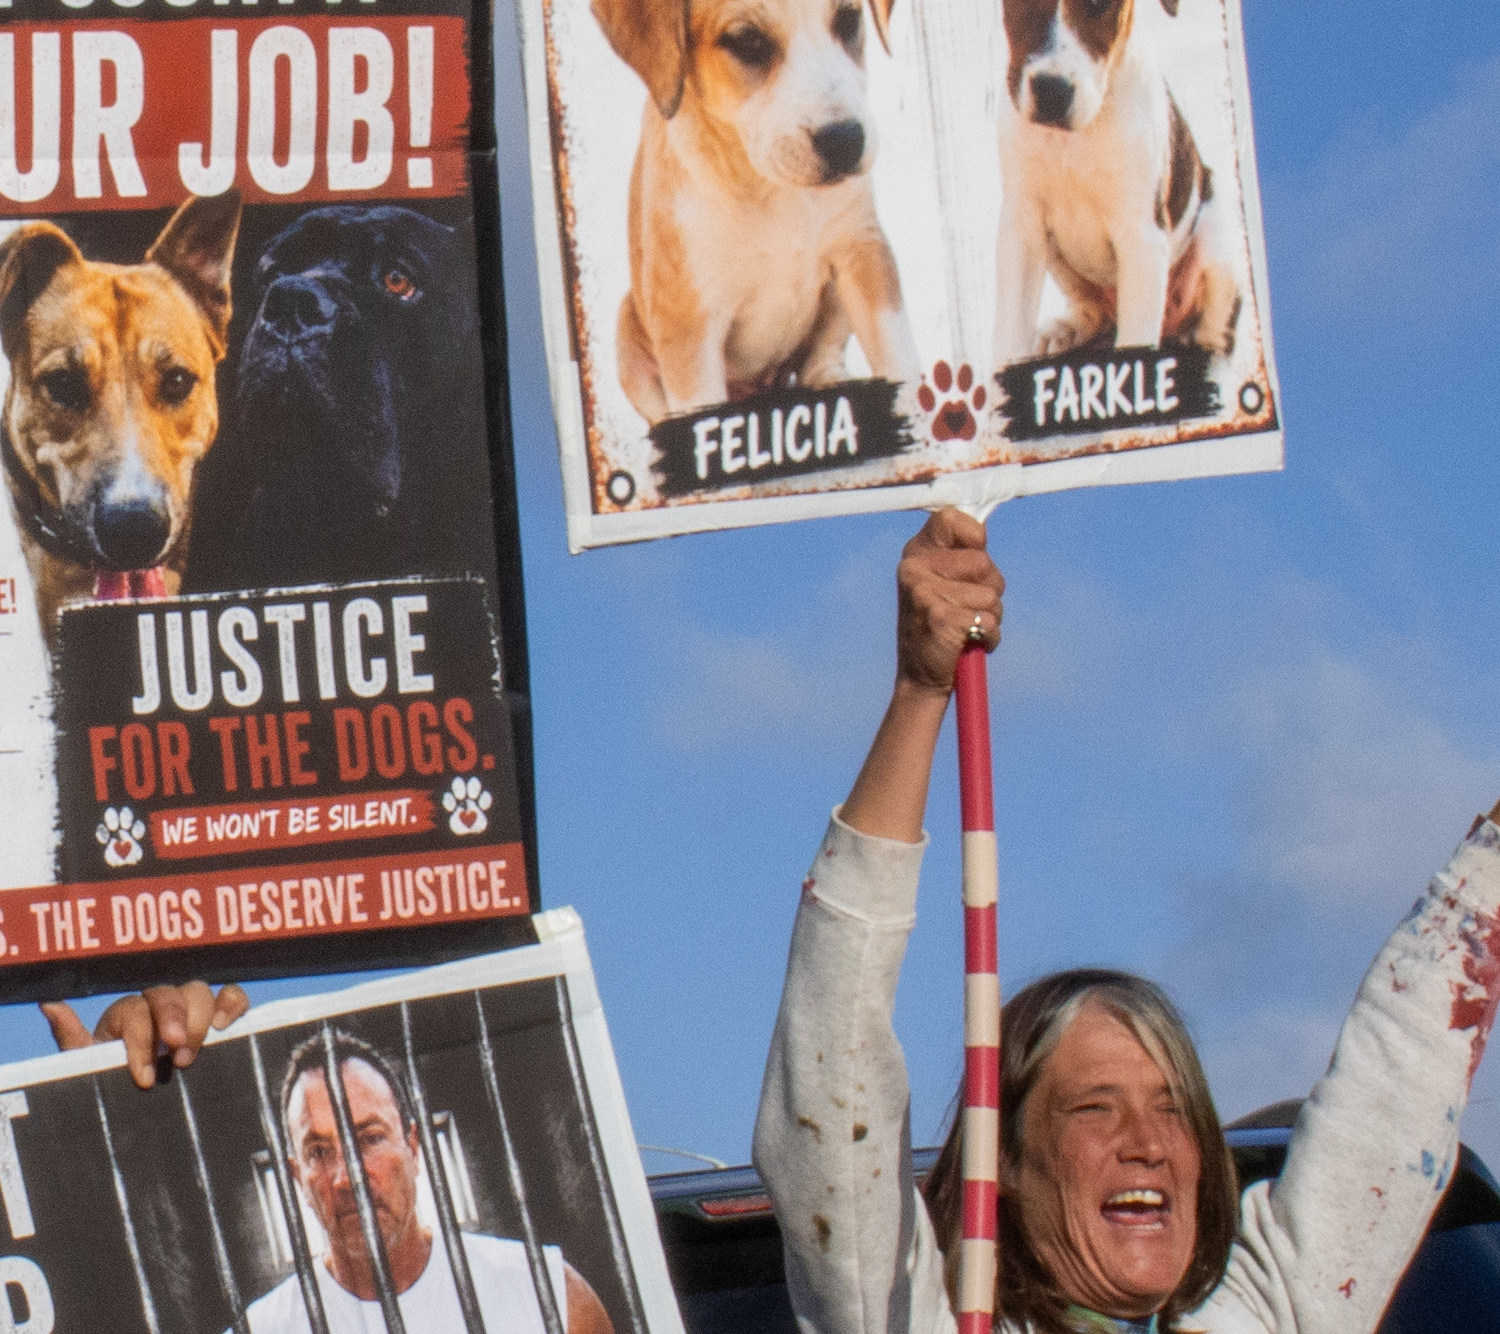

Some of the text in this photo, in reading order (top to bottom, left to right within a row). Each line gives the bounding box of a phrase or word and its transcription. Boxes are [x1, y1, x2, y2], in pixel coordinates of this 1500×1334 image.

[178, 24, 435, 199] JOB!
[692, 397, 859, 479] FELICIA
[1033, 358, 1179, 426] FARKLE
[132, 595, 435, 715] JUSTICE
[89, 697, 495, 802] FOR THE DOGS.
[162, 797, 418, 847] WE WON'T BE SILENT.
[29, 898, 100, 952] THE
[111, 887, 204, 946] DOGS
[217, 872, 369, 936] DESERVE
[380, 859, 521, 923] JUSTICE.
